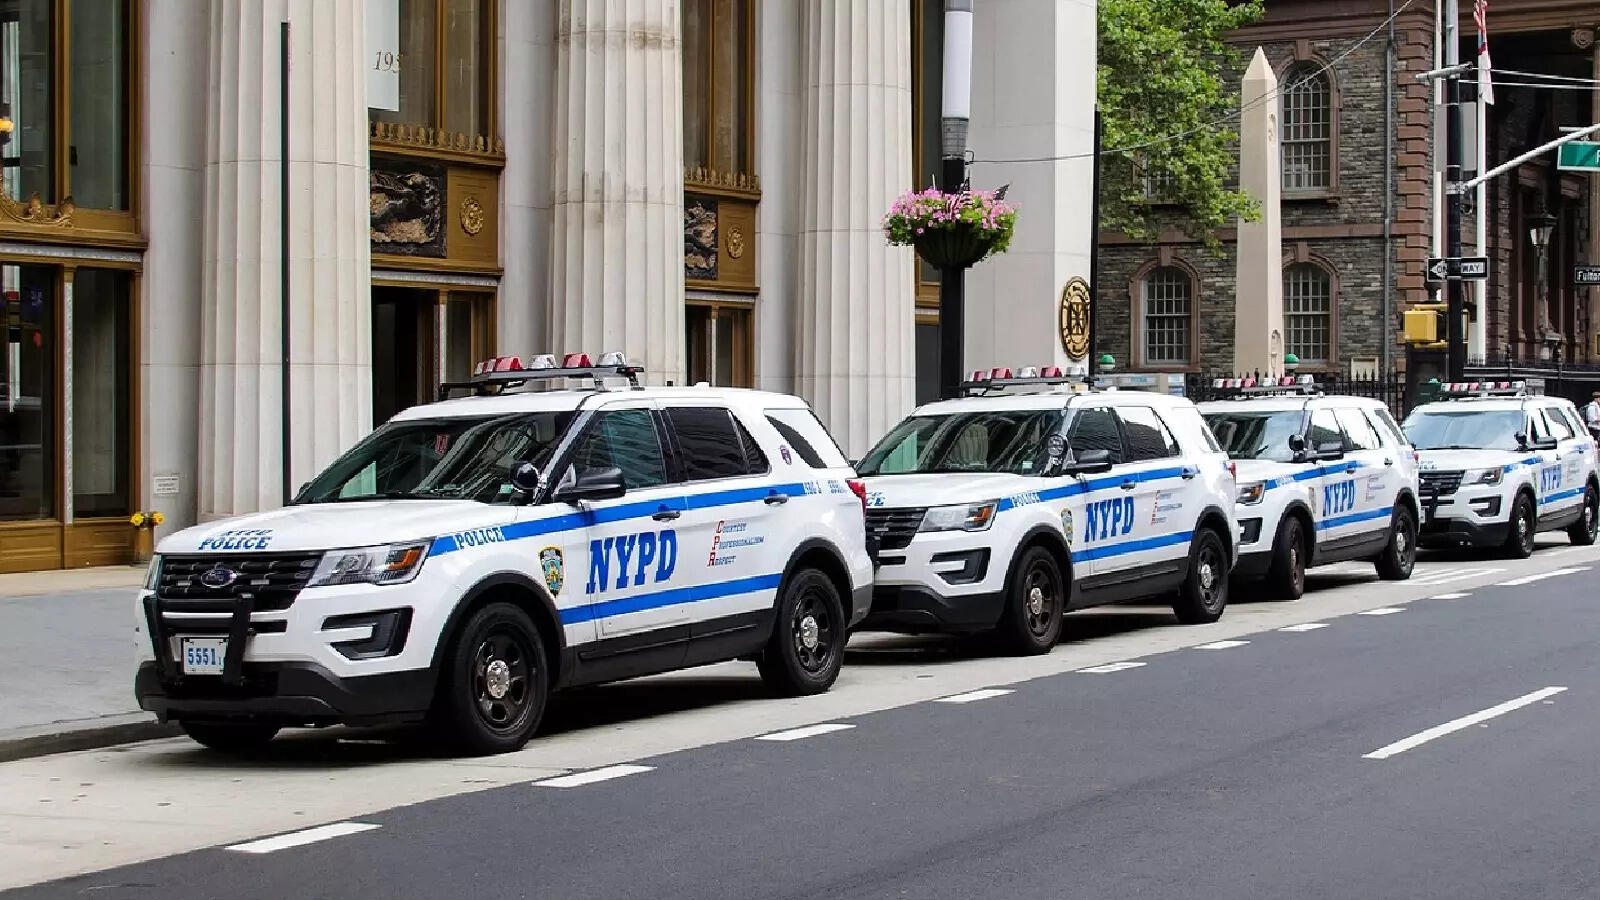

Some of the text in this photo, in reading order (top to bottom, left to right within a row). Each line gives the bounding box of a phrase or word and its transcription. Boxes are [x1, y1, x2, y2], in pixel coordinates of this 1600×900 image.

[1462, 264, 1480, 273] WAY
[1323, 480, 1355, 517] NYPD
[1084, 496, 1134, 542] NYPD
[199, 537, 272, 550] POLICE
[455, 527, 504, 549] POLICE
[586, 529, 677, 594] NYPD
[188, 648, 216, 665] 5551
